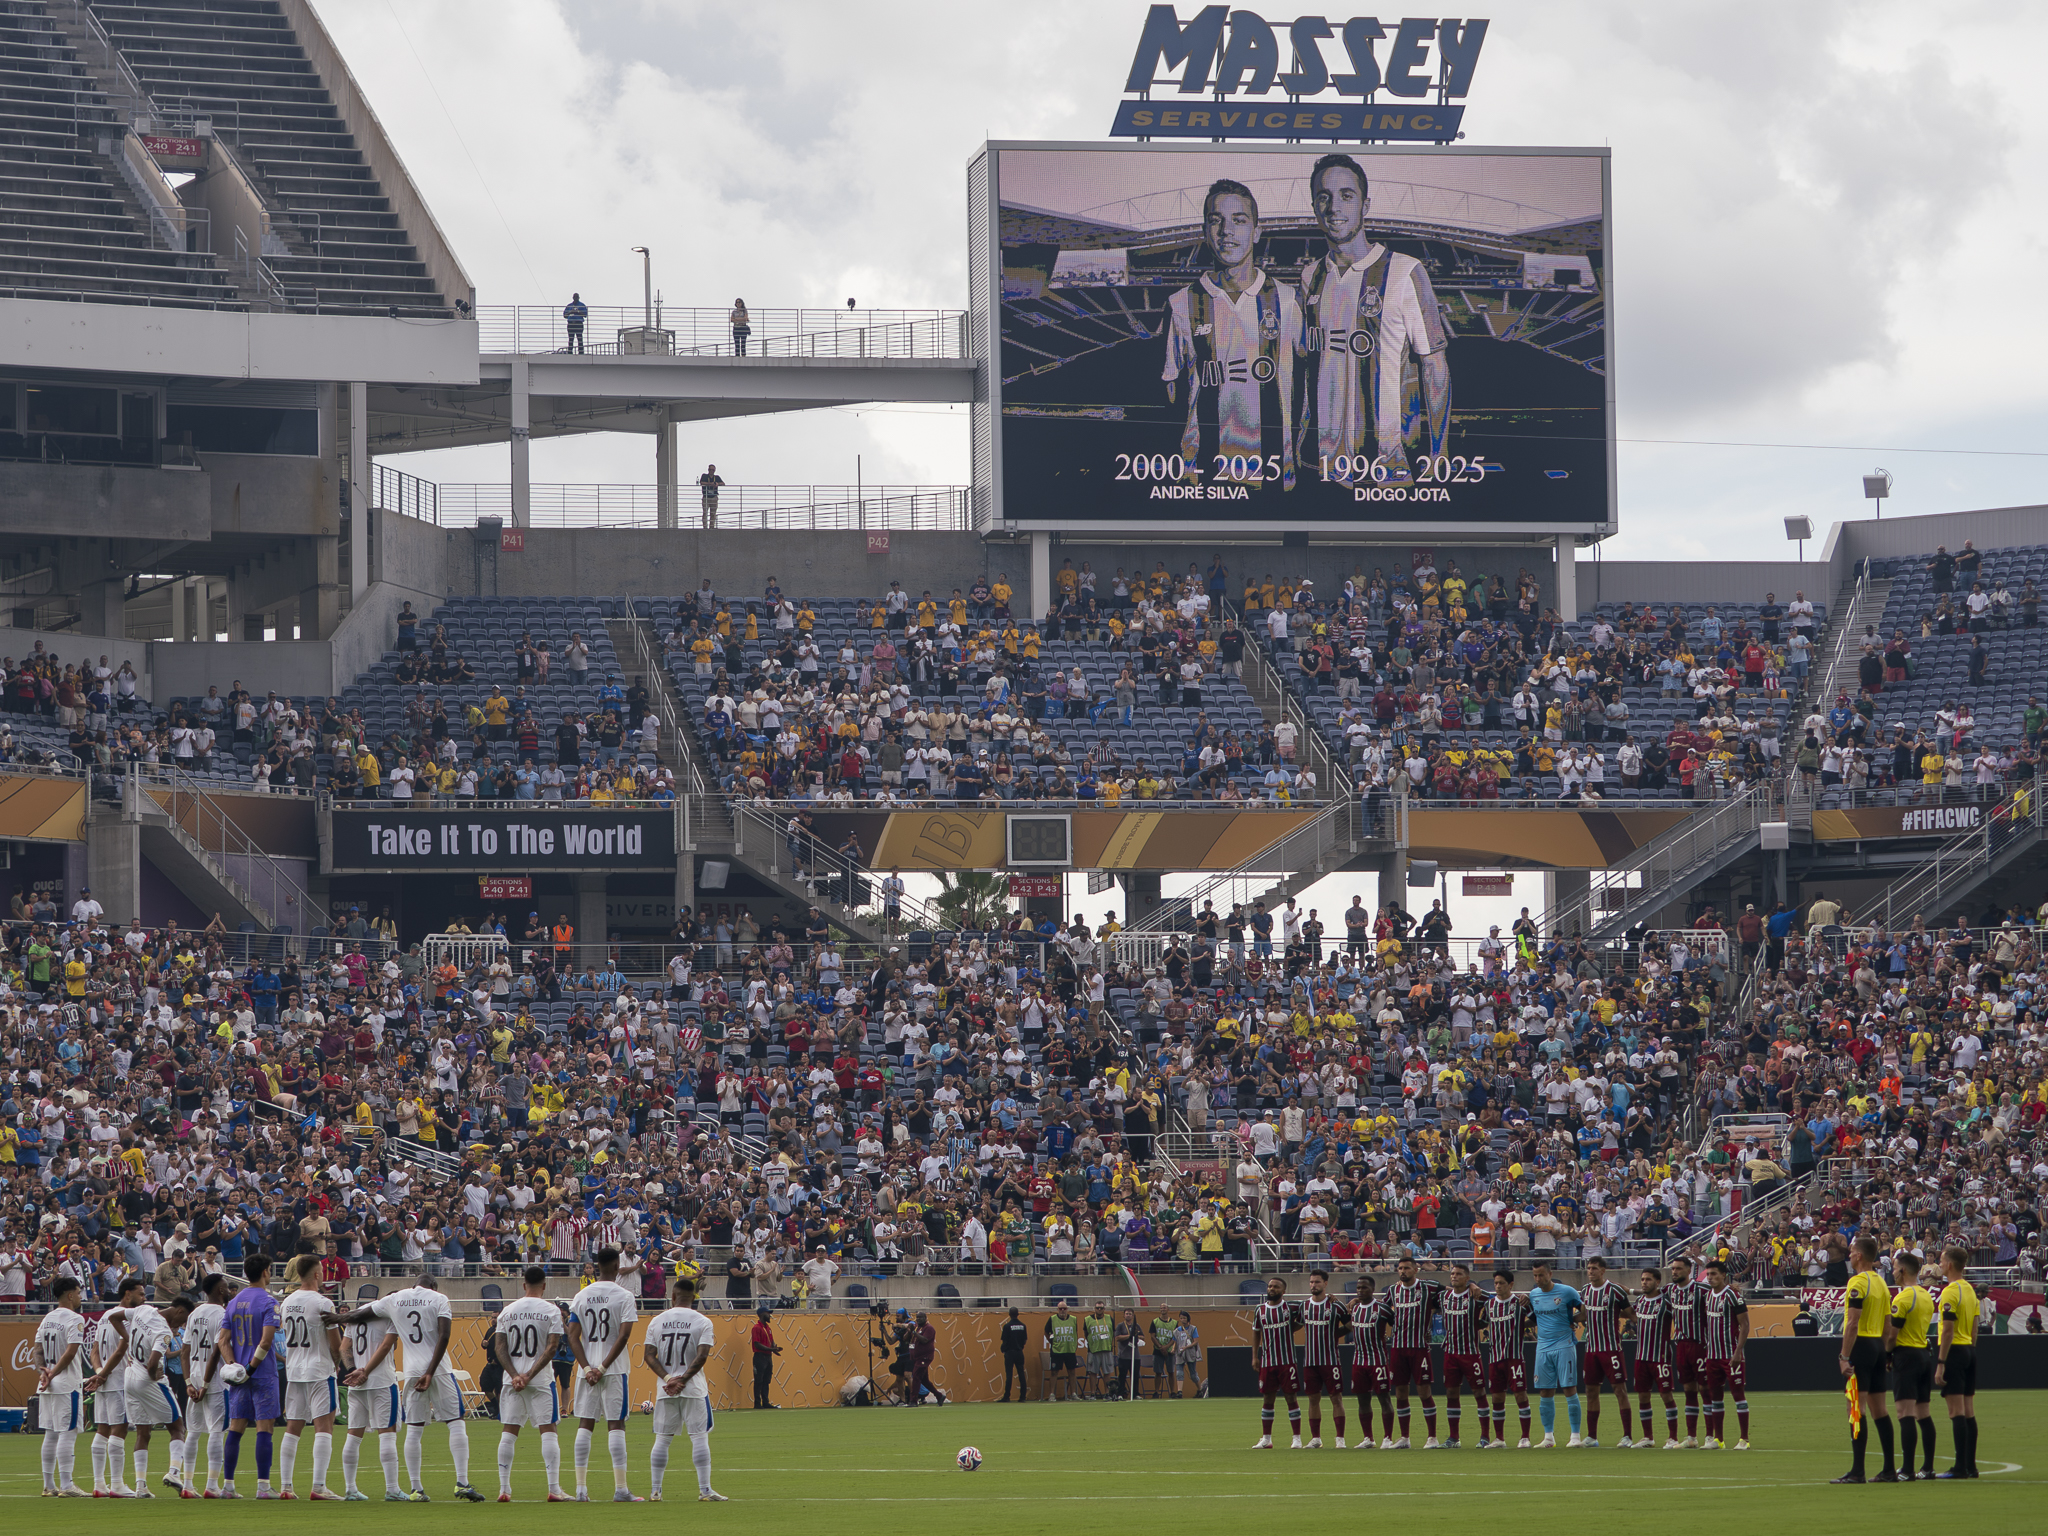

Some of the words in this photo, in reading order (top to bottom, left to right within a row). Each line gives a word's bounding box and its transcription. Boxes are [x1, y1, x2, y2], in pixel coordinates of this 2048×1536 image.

[1124, 4, 1490, 98] MASSEY
[1131, 110, 1343, 130] SERVICES
[1362, 113, 1443, 131] INC.
[146, 142, 168, 150] 240
[176, 144, 196, 152] 241
[1115, 454, 1185, 481] 2000
[1213, 454, 1281, 482] 2025
[1319, 454, 1388, 482] 1996
[1416, 455, 1485, 483] 2025
[1150, 484, 1204, 499] ANDRÉ
[1207, 486, 1249, 500] SILVA
[1354, 487, 1407, 501] DIOGO
[1409, 488, 1450, 502] JOTA
[502, 534, 522, 547] P41
[868, 536, 889, 549] P42
[1413, 553, 1432, 564] P3
[1902, 807, 1980, 831] #FIFACWC
[368, 824, 431, 855] Take
[440, 824, 459, 855] It
[468, 824, 497, 855] To
[507, 824, 554, 855] The
[563, 824, 642, 855] World
[33, 881, 54, 891] OUC
[483, 886, 489, 894] P
[491, 886, 503, 894] 40
[509, 886, 515, 894] P
[517, 886, 528, 894] 41
[1485, 884, 1496, 892] 43
[66, 1008, 79, 1022] 10
[396, 1298, 433, 1307] KOULIBALY
[587, 1296, 609, 1304] KANNO
[286, 1305, 305, 1314] SERGEJ
[519, 1312, 549, 1322] CANCELO
[232, 1314, 253, 1346] 37
[285, 1315, 310, 1348] 22
[407, 1310, 423, 1344] 3
[585, 1308, 610, 1343] 28
[662, 1322, 691, 1330] MALCOM
[1055, 1326, 1074, 1335] FIFA
[1090, 1324, 1109, 1335] FIFA
[1263, 1320, 1290, 1329] SUPERBET
[356, 1322, 368, 1356] 8
[1156, 1328, 1173, 1338] FIFA
[44, 1332, 57, 1364] 11
[131, 1328, 144, 1363] 16
[191, 1328, 211, 1362] 24
[508, 1324, 538, 1358] 20
[661, 1332, 691, 1366] 77
[1421, 1357, 1428, 1370] 4
[1473, 1362, 1481, 1375] 3
[1567, 1360, 1572, 1374] 1
[1611, 1356, 1620, 1369] 5
[1289, 1366, 1296, 1380] 2
[1332, 1367, 1340, 1380] 8
[1375, 1366, 1388, 1381] 21
[1511, 1365, 1523, 1379] 14
[1657, 1364, 1670, 1378] 16
